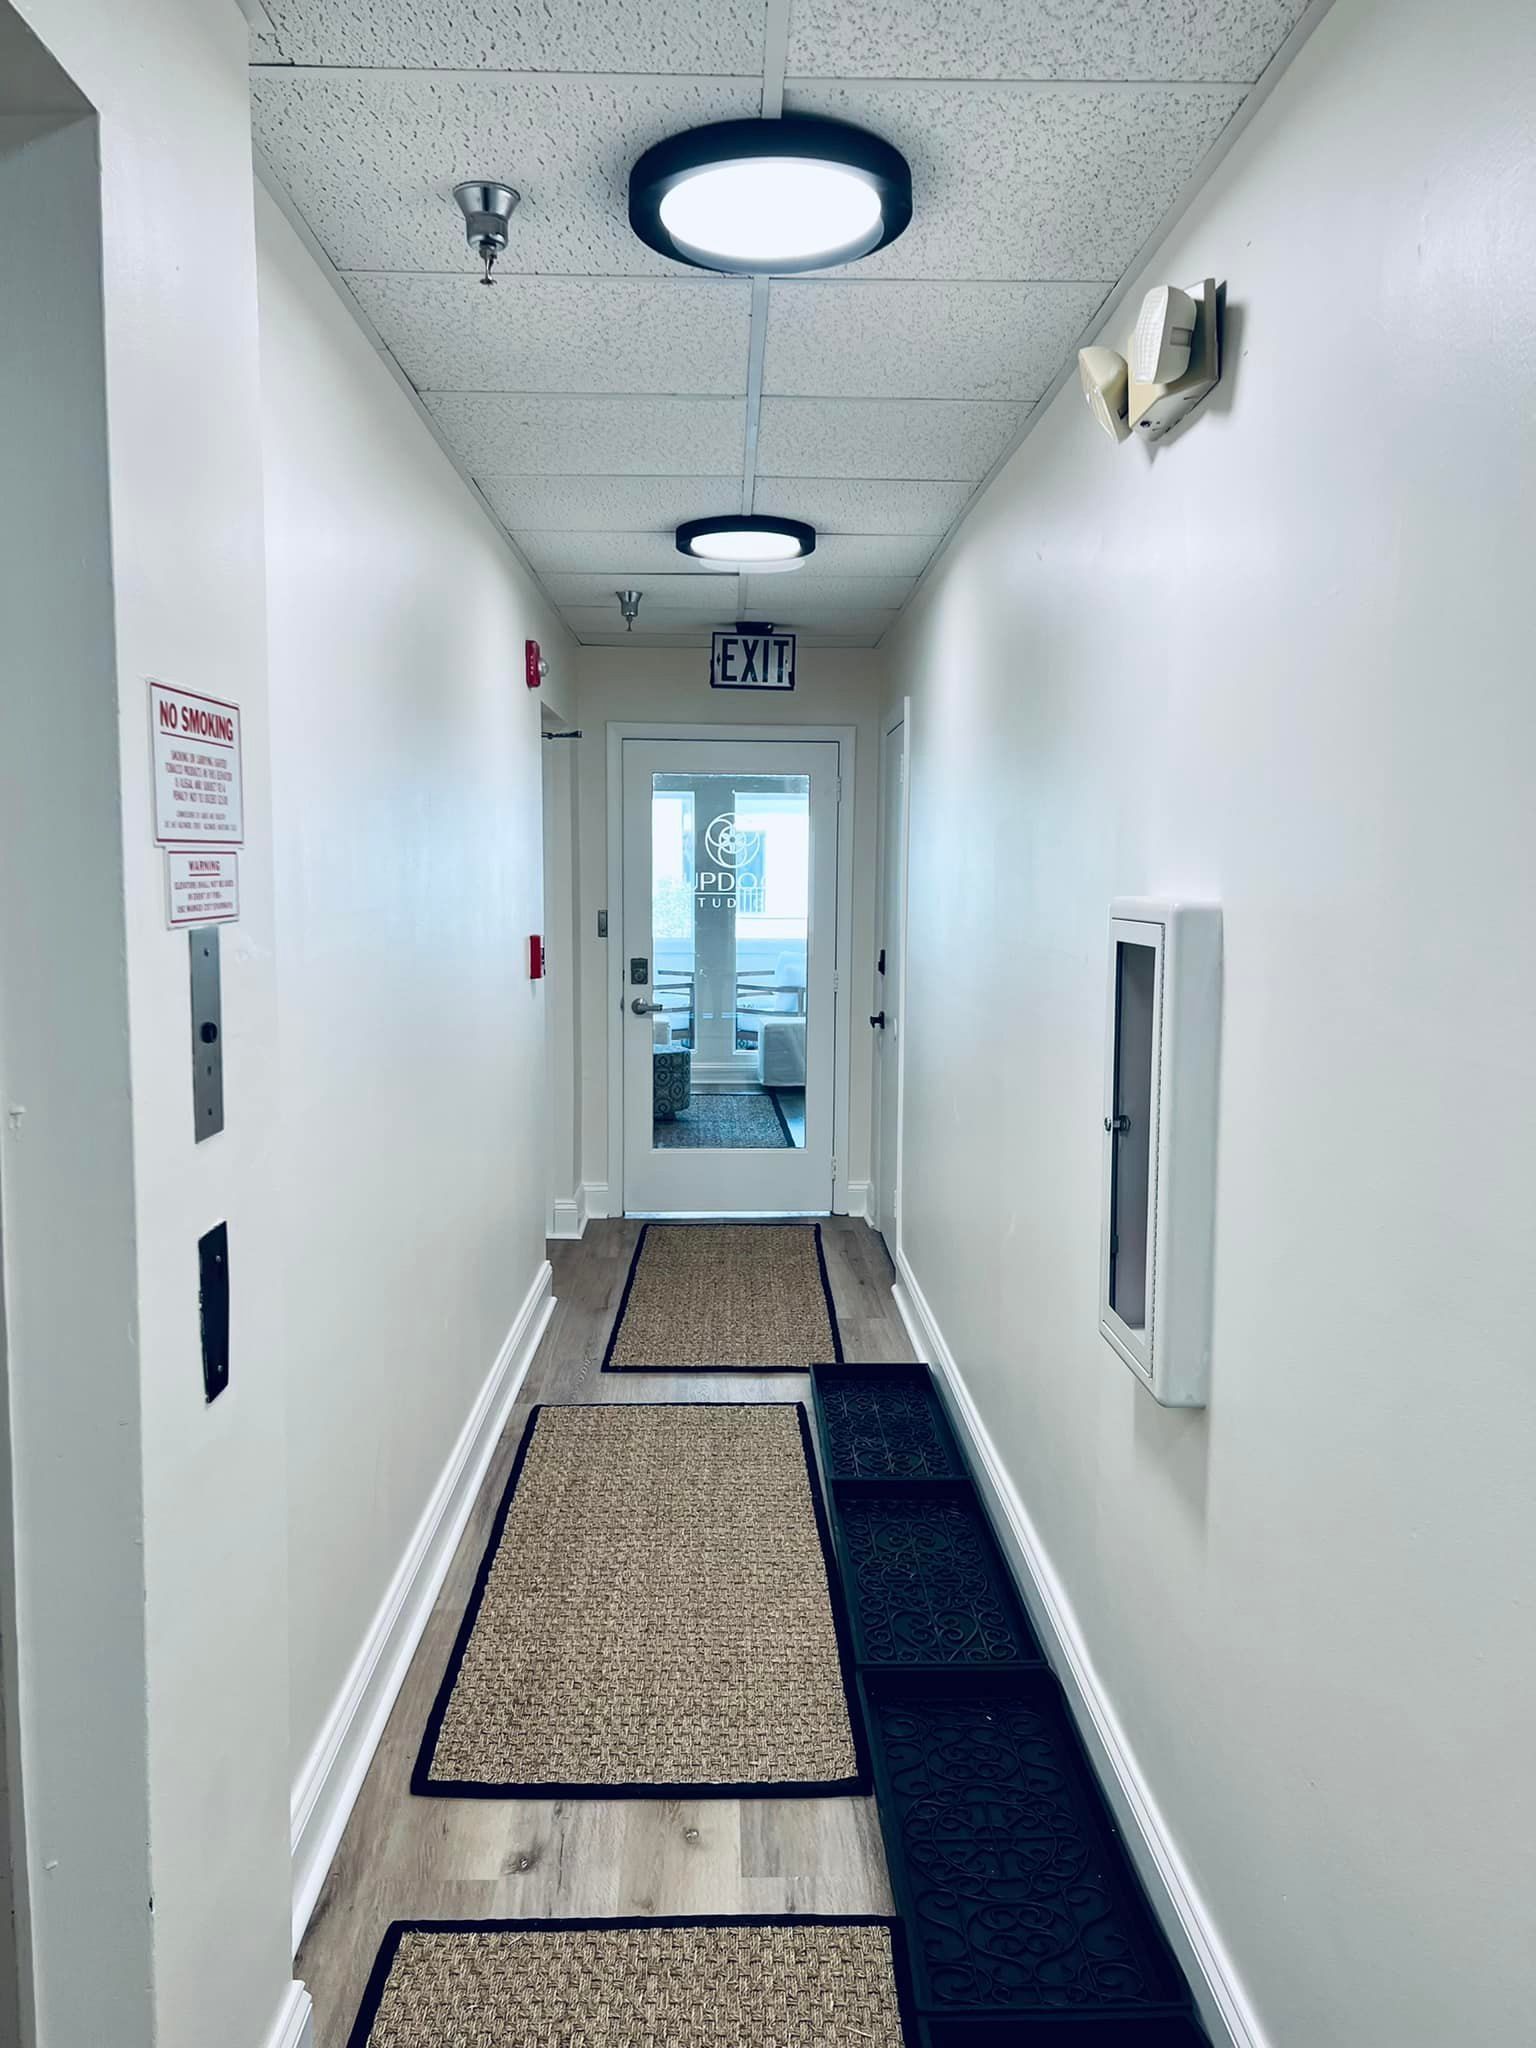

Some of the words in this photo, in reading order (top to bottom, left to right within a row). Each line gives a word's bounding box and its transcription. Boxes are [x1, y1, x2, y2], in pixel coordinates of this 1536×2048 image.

[721, 639, 790, 683] EXIT
[159, 699, 178, 730] NO
[181, 705, 234, 743] SMOKING
[188, 860, 221, 872] WARNING
